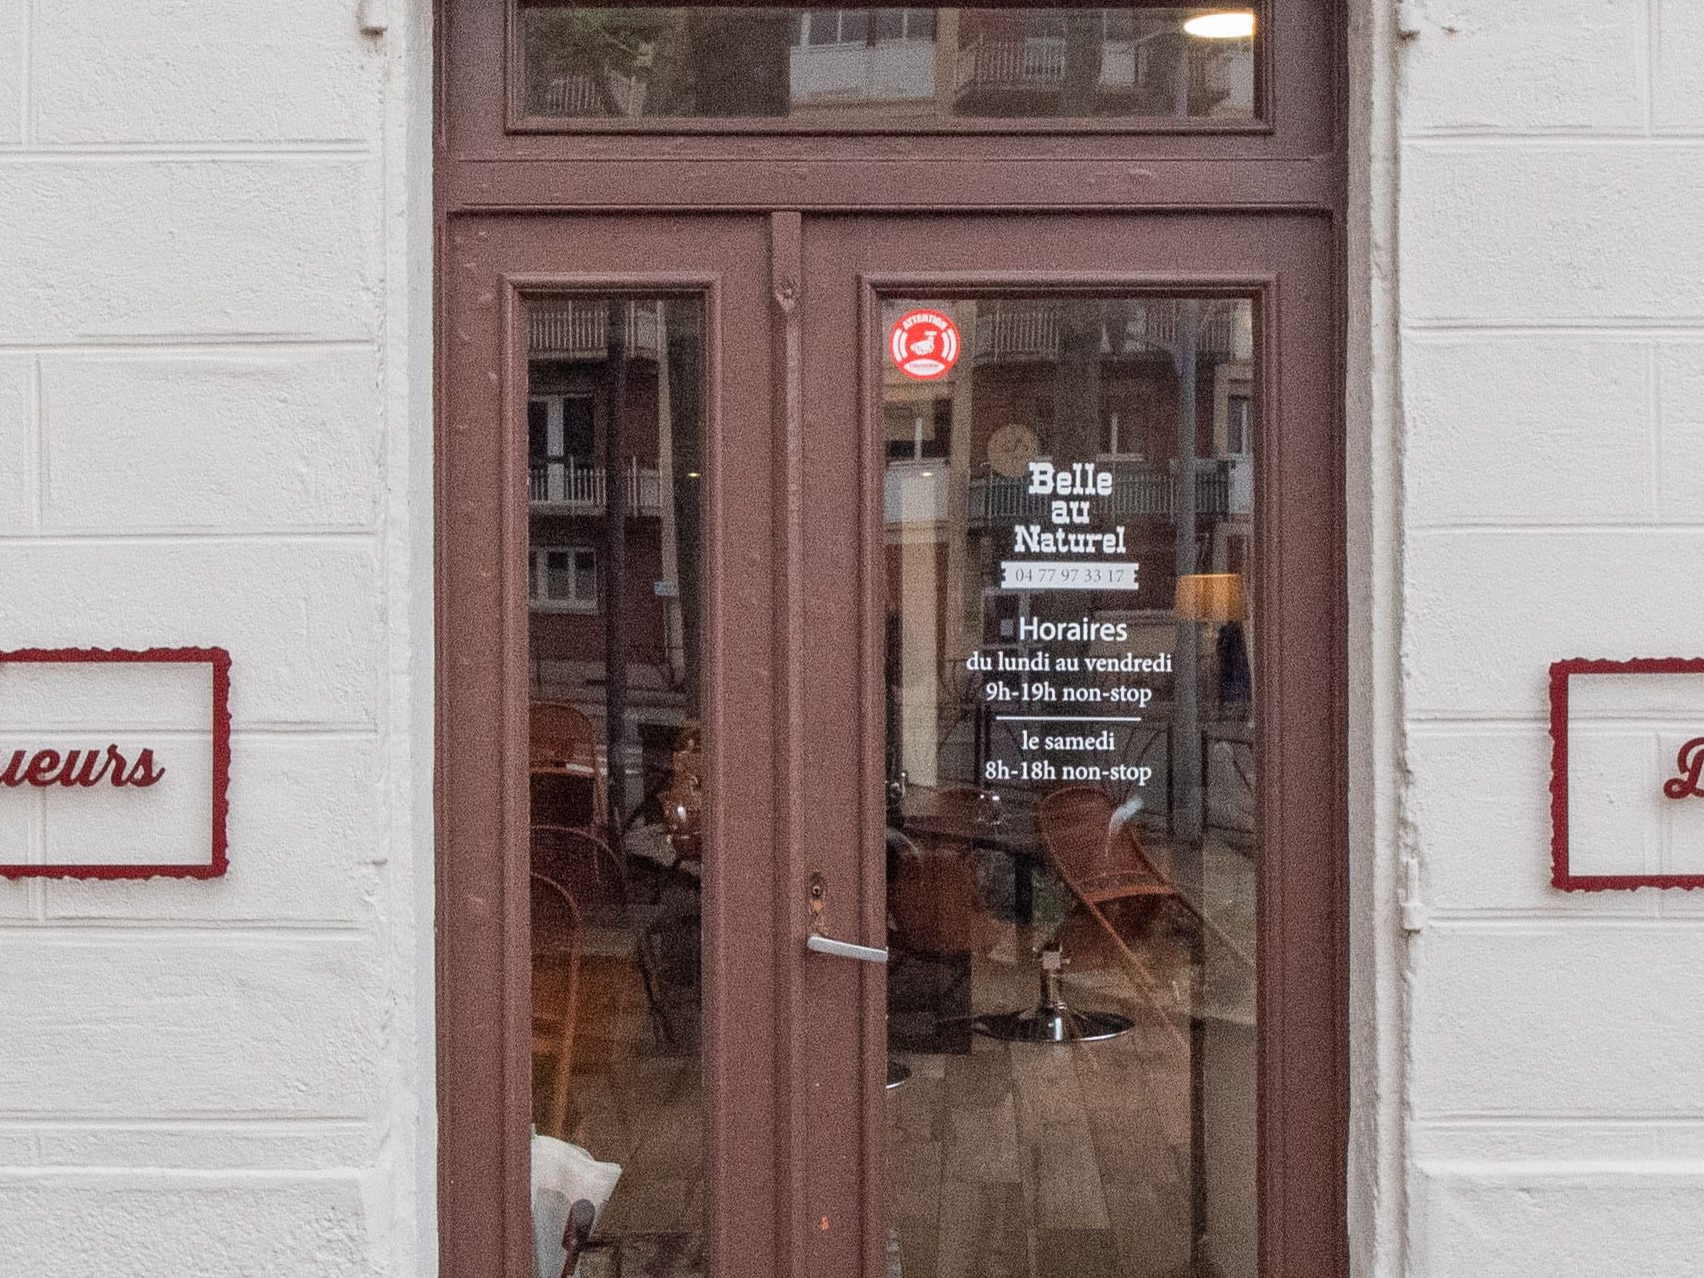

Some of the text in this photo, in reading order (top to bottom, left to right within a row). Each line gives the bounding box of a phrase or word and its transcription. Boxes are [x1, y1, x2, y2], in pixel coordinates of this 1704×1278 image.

[1028, 462, 1113, 496] Belle
[1051, 500, 1090, 524] au
[1014, 525, 1126, 554] Naturel
[1015, 569, 1124, 583] 04 77 97 33 17
[1019, 617, 1128, 642] Horaires
[966, 651, 1173, 673] du lundi au vendredi
[986, 681, 1152, 707] 9h-19h non-stop
[1022, 730, 1116, 751] le samedi
[985, 759, 1152, 786] 8h-18h non-stop
